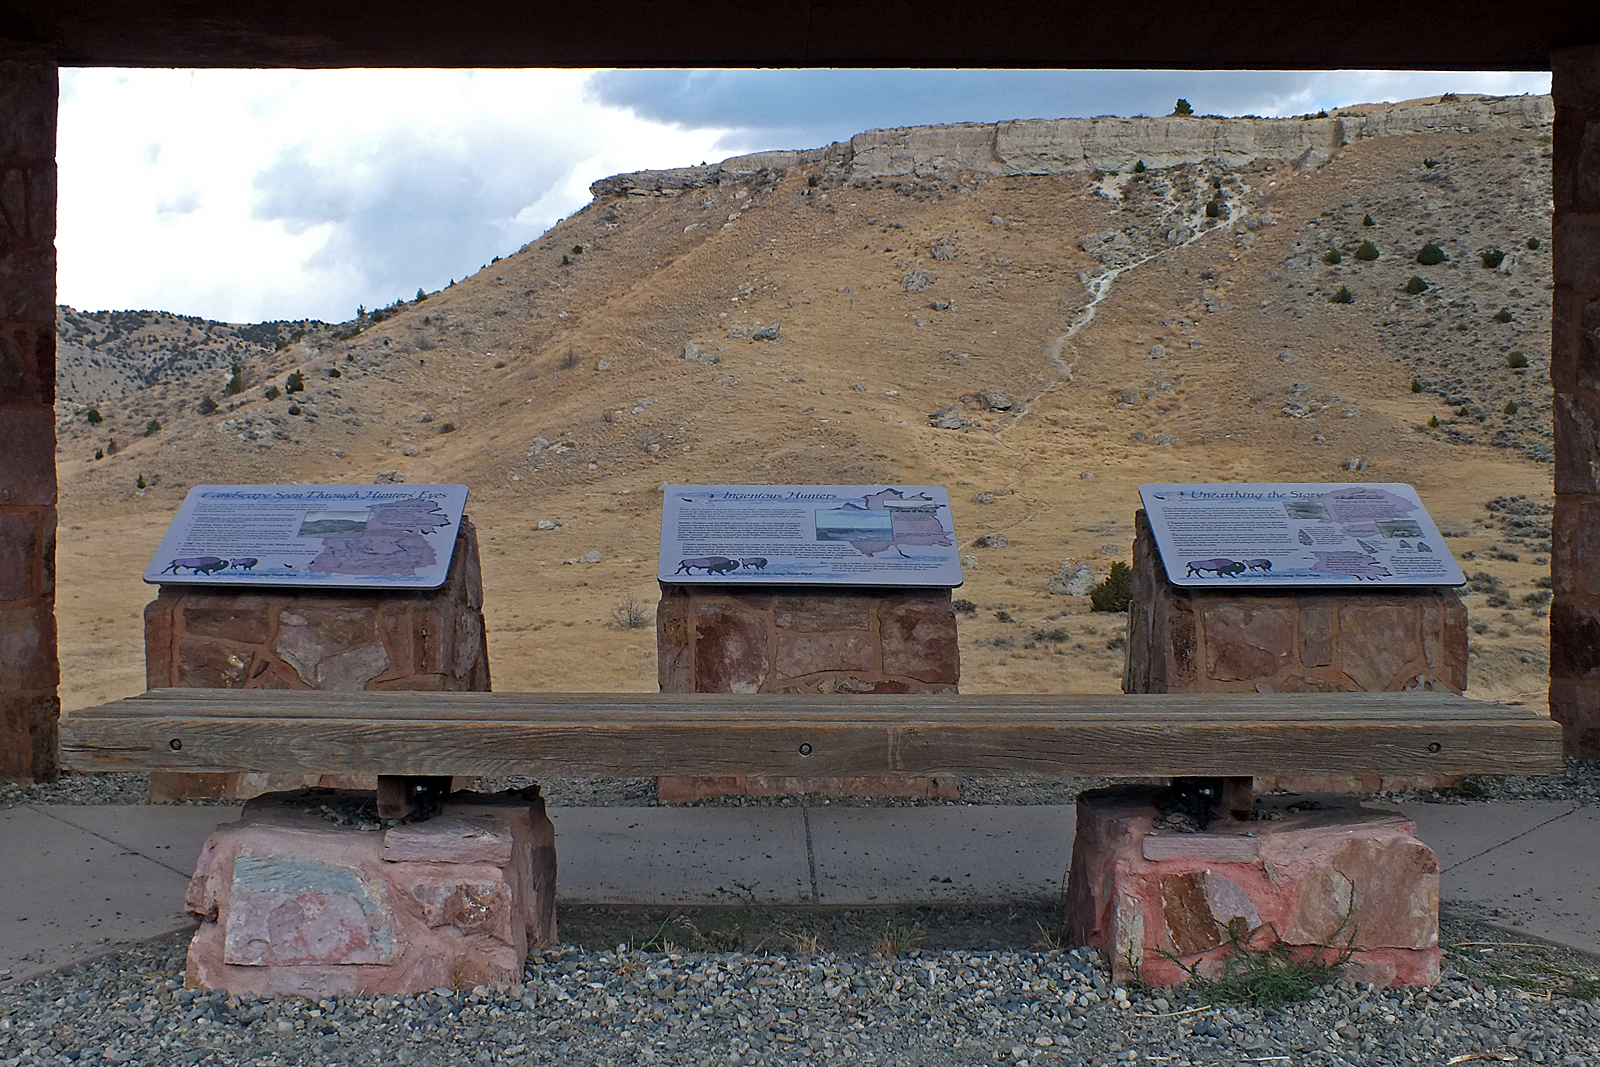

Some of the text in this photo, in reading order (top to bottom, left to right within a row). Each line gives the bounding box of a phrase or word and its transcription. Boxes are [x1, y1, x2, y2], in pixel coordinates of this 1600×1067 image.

[274, 491, 303, 499] Seen
[306, 490, 359, 500] Through
[419, 490, 448, 500] Eyes
[785, 491, 837, 500] Hunters
[1191, 490, 1323, 500] Unearthing the Story
